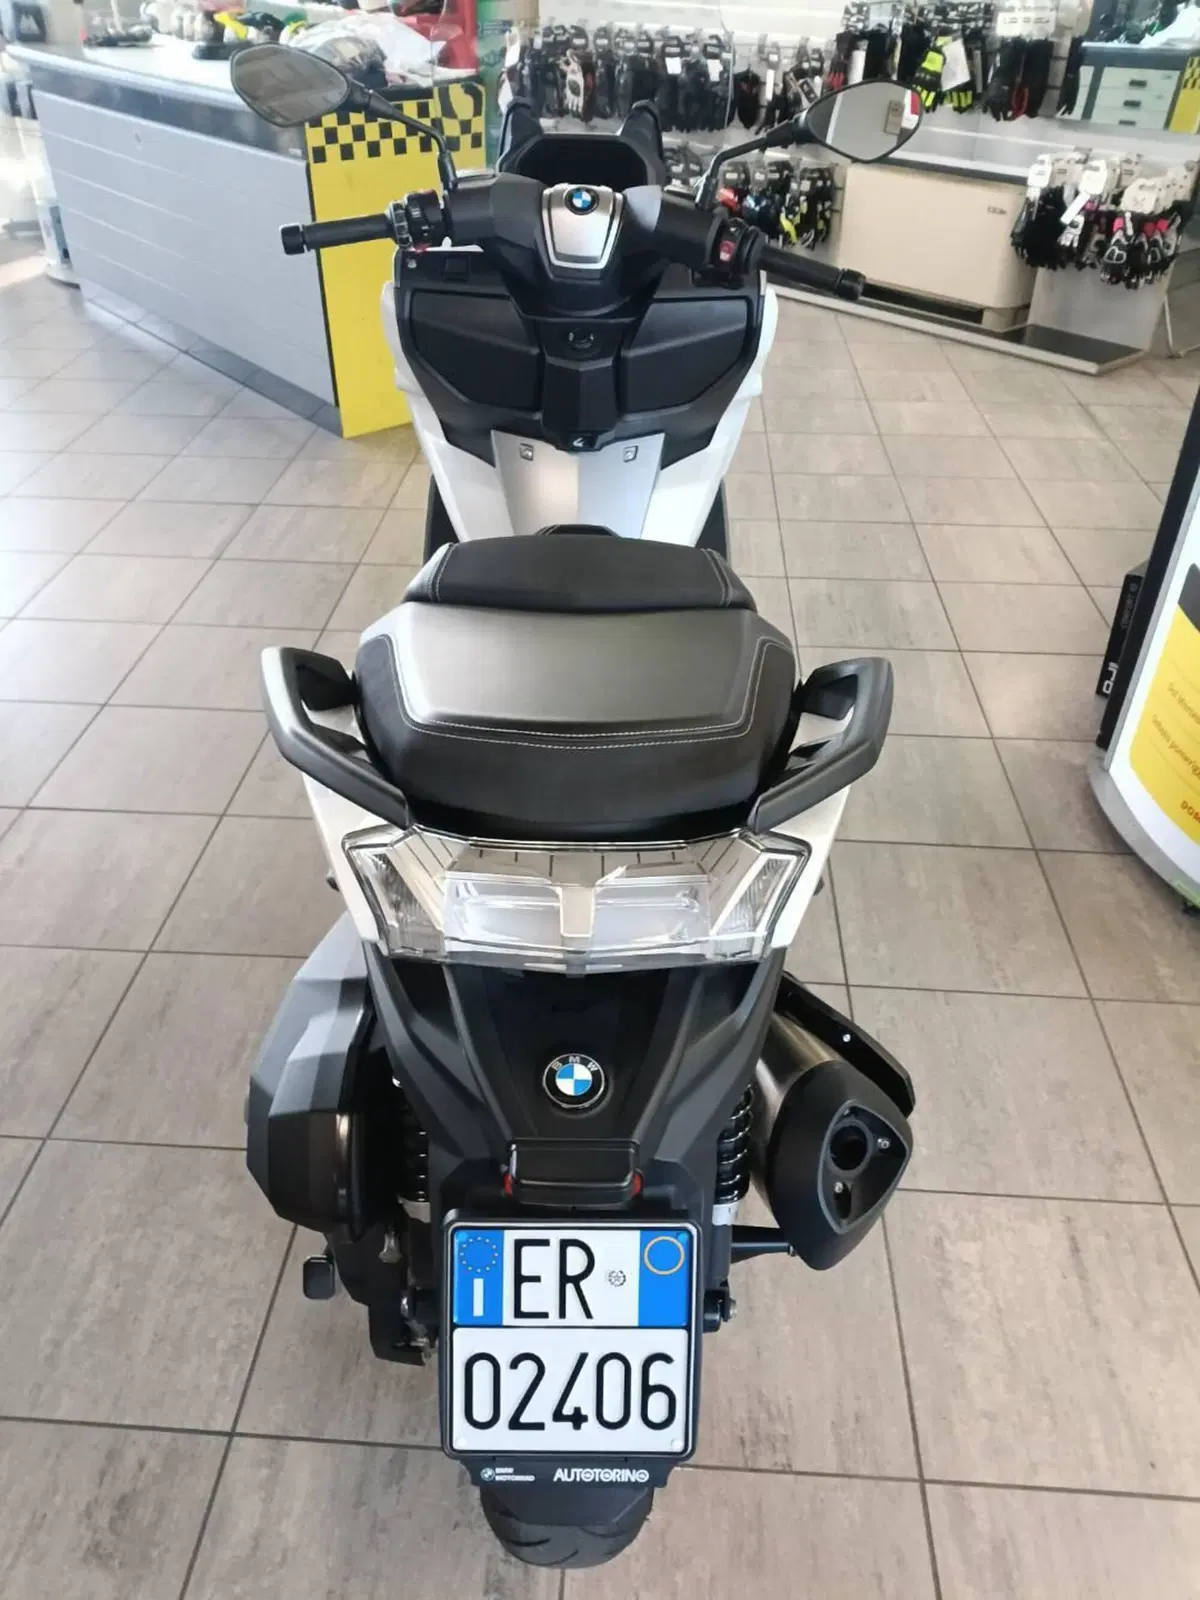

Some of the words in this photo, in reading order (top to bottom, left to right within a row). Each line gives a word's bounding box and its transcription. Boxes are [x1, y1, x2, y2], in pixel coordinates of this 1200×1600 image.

[550, 1055, 599, 1071] BMW
[513, 1238, 595, 1319] ER
[464, 1352, 677, 1431] 02406
[553, 1467, 650, 1483] AUTOTORINO
